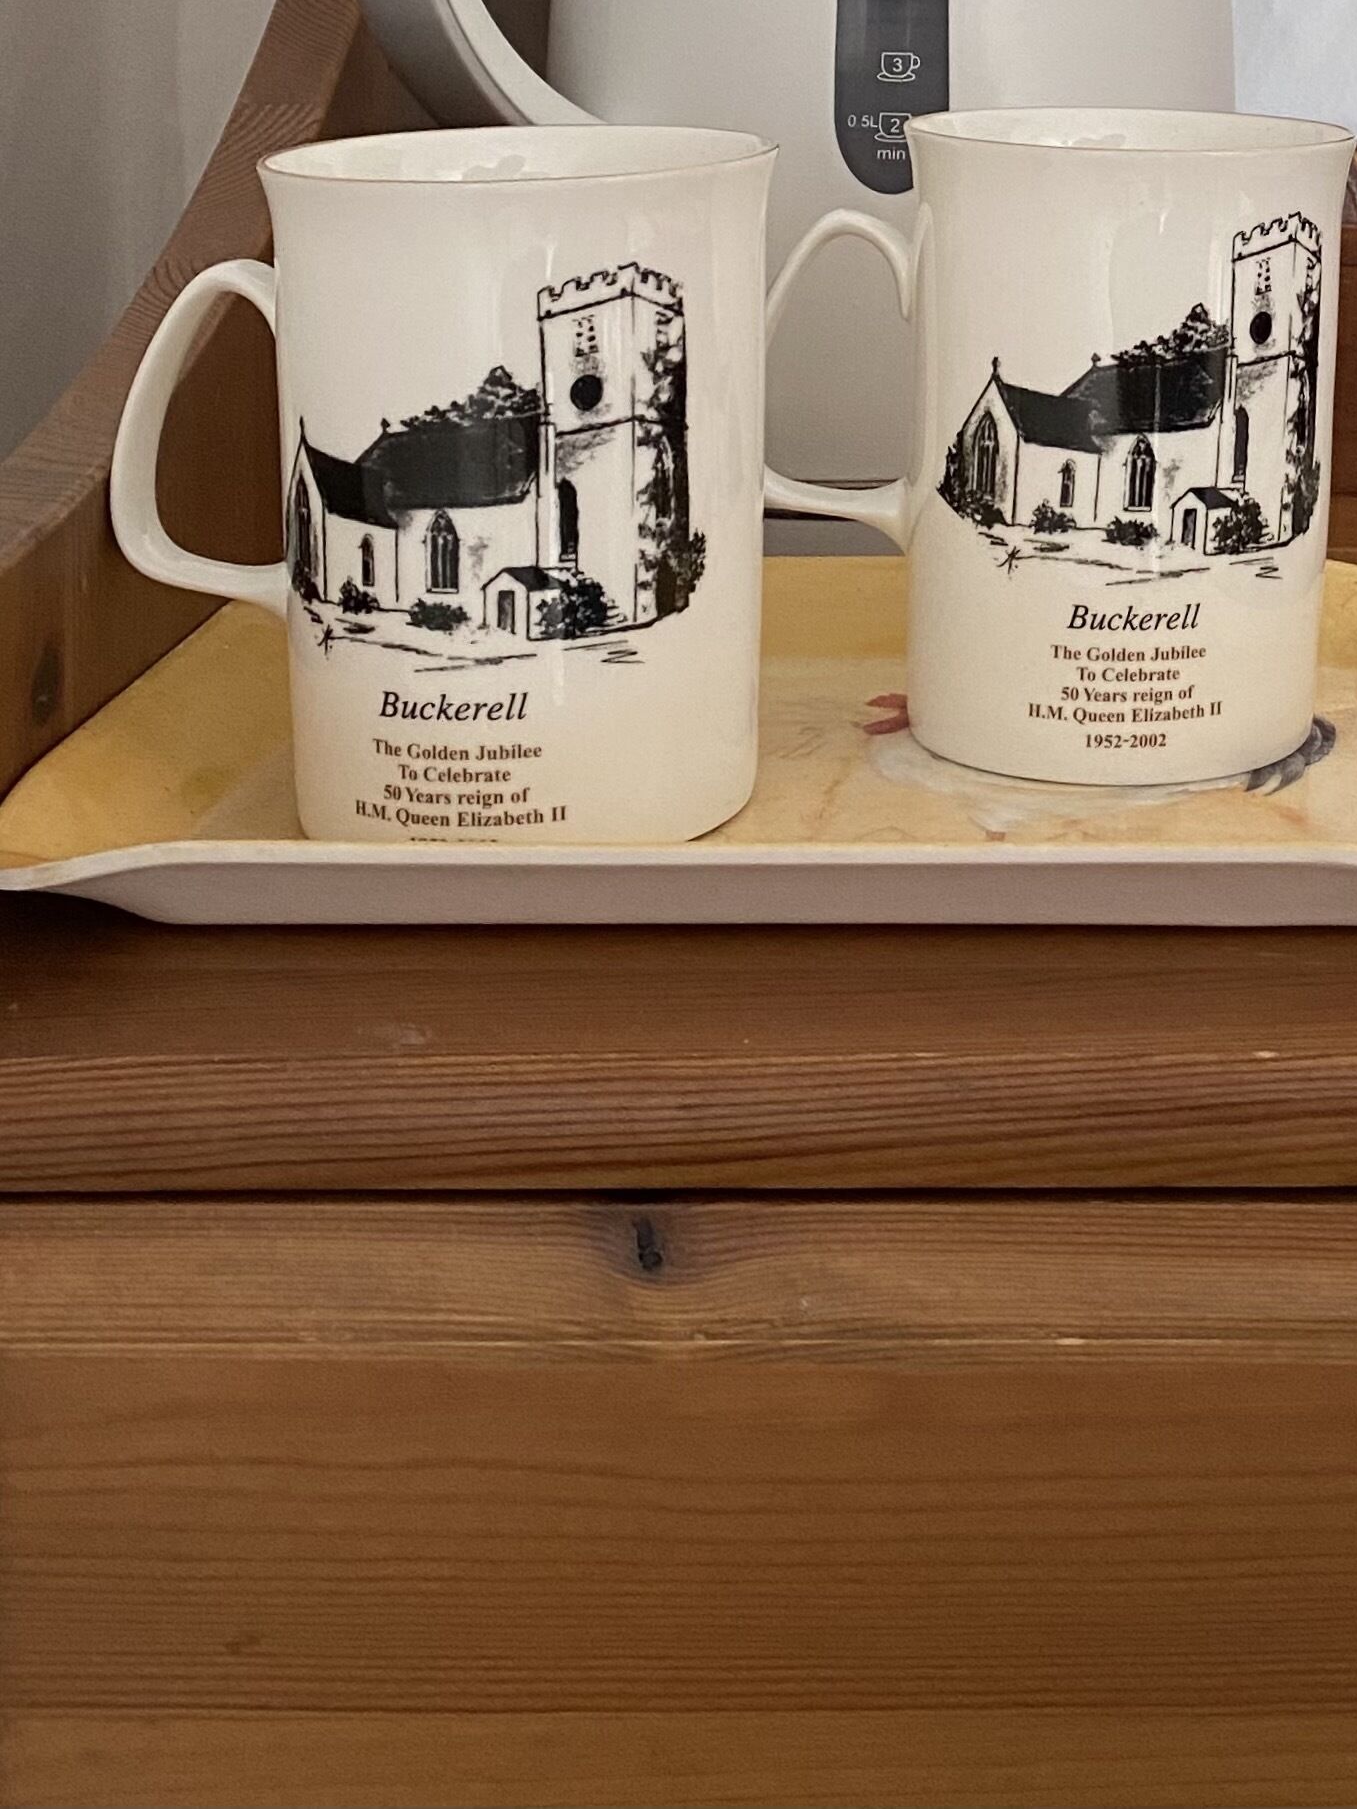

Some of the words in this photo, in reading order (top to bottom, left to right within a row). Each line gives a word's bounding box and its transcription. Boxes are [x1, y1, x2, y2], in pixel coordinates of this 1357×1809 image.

[892, 57, 903, 72] 3
[847, 114, 878, 128] 05L
[889, 118, 901, 133] 2
[876, 147, 906, 160] min
[1067, 603, 1201, 631] Buckerell
[1050, 644, 1082, 661] The
[1086, 646, 1145, 662] Golden
[1150, 645, 1206, 662] Jubilee
[1076, 666, 1096, 682] To
[1101, 666, 1180, 683] Celebrate
[1060, 687, 1079, 702] 50
[1084, 687, 1127, 703] Years
[1133, 686, 1173, 704] reign
[1178, 684, 1195, 700] of
[379, 690, 529, 722] Buckerell
[1028, 702, 1068, 722] H.M.
[1073, 707, 1125, 725] Queen
[1131, 703, 1205, 723] Elizabeth
[1209, 701, 1223, 716] II
[372, 738, 402, 758] The
[406, 743, 470, 761] Golden
[475, 744, 543, 761] Jubilee
[1085, 733, 1167, 749] 1952-2002
[398, 764, 418, 781] To
[423, 766, 512, 783] Celebrate
[383, 784, 402, 801] 50
[404, 786, 452, 805] Years
[457, 789, 504, 809] reign
[511, 787, 531, 803] of
[355, 800, 392, 822] H.M.
[395, 807, 450, 829] Queen
[457, 805, 544, 828] Elizabeth
[551, 805, 567, 822] II
